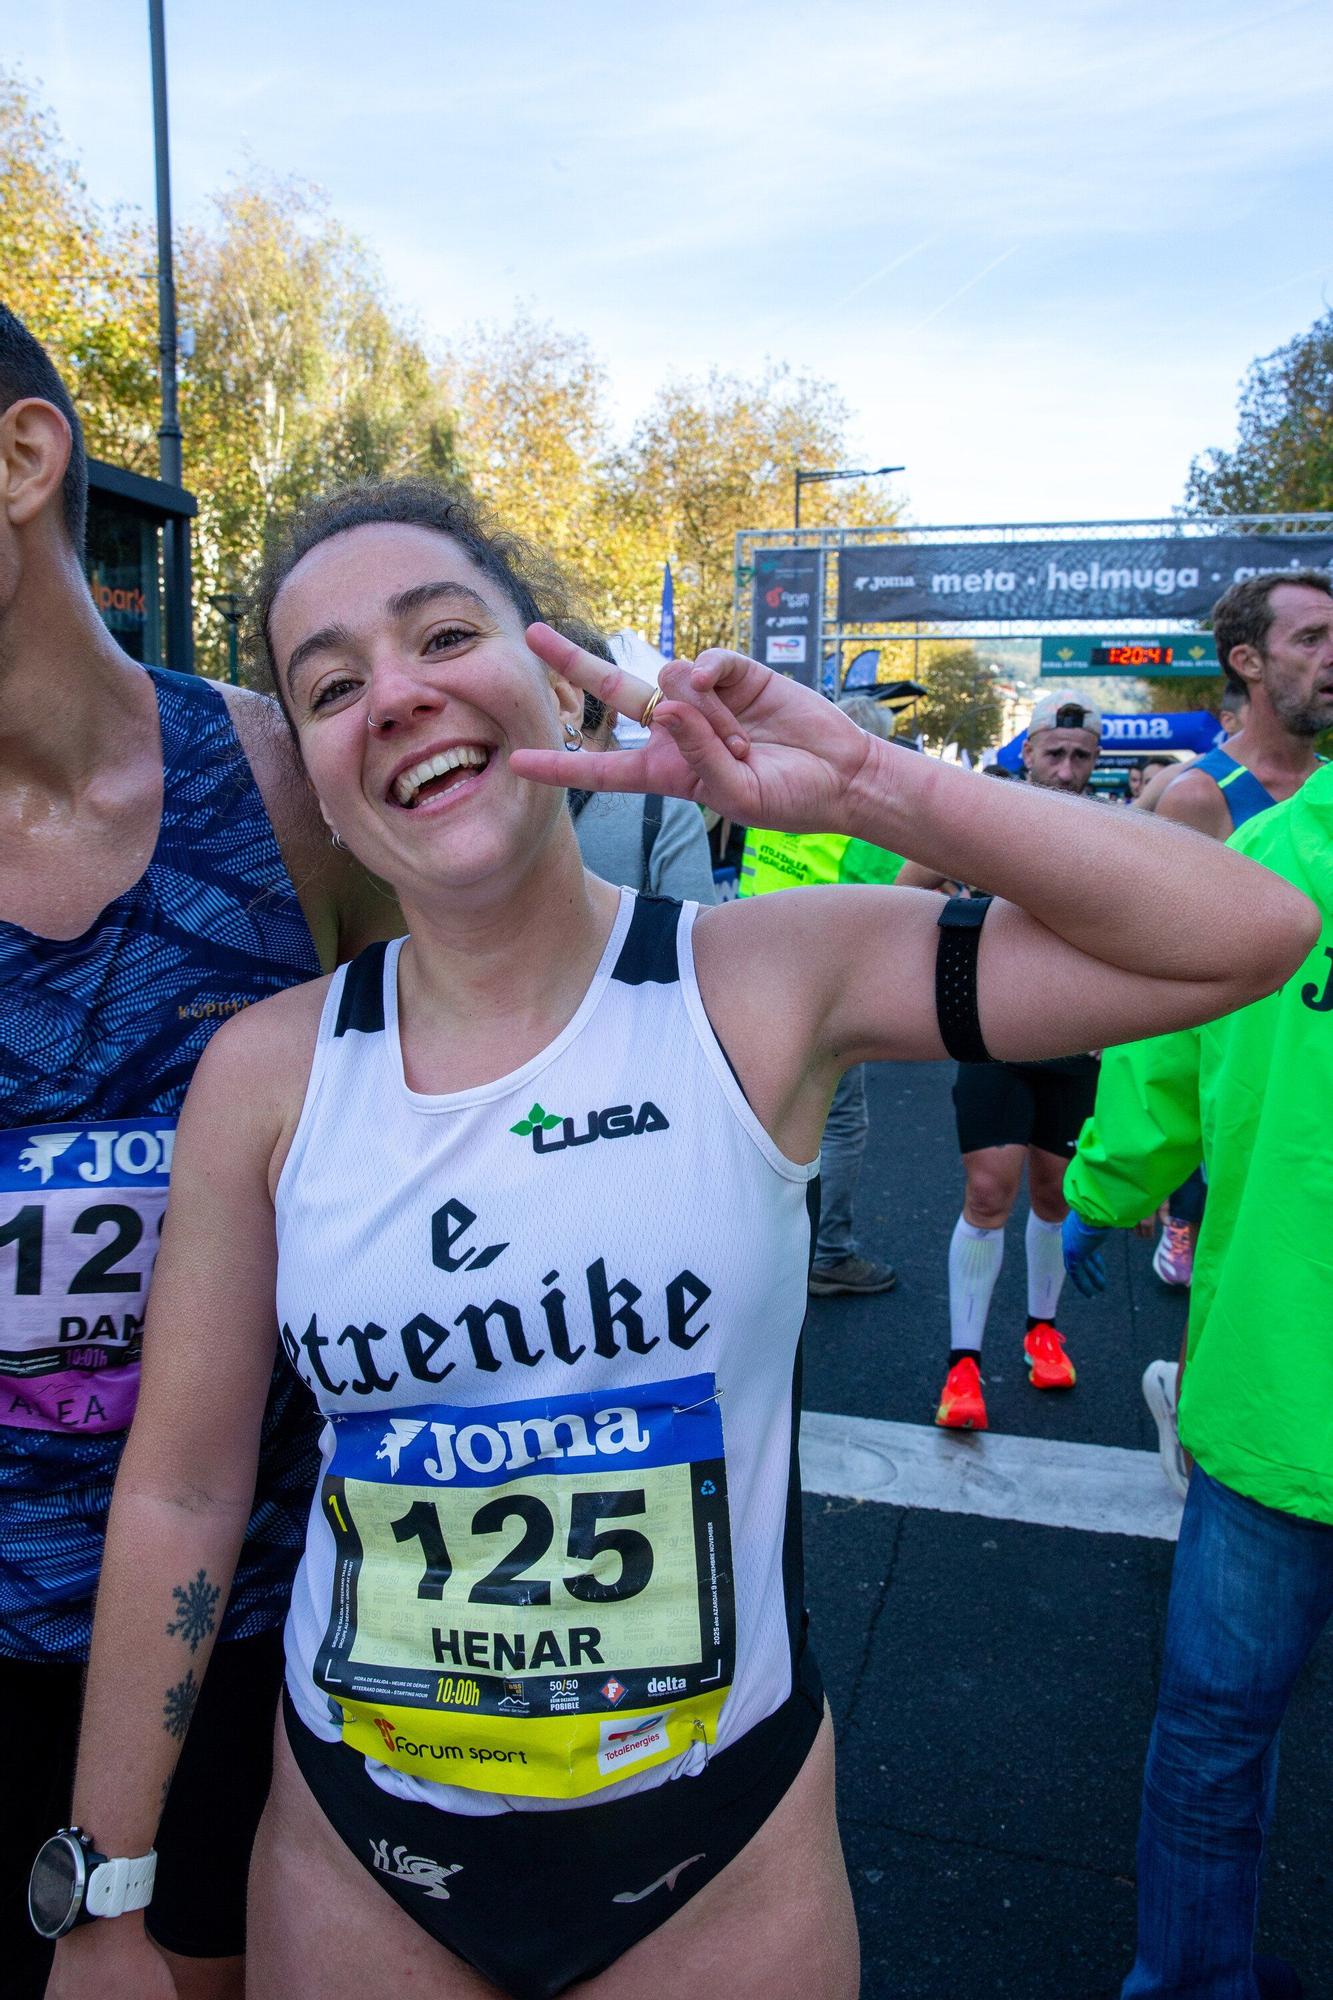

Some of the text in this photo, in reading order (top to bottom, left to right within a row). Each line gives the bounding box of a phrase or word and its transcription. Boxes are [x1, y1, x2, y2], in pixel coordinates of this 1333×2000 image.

[931, 561, 1198, 595] meta helmuga
[1109, 646, 1173, 665] 1:20:41
[0, 1203, 164, 1296] 12
[328, 1495, 348, 1533] 1
[390, 1488, 655, 1606] 125
[431, 1626, 605, 1671] HENAR
[436, 1677, 480, 1706] 10:00h
[550, 1679, 578, 1691] 50/50
[647, 1676, 686, 1693] delta
[550, 1702, 579, 1711] POSIBLE
[396, 1735, 527, 1767] Forum sport
[605, 1733, 660, 1760] TotalEnergies
